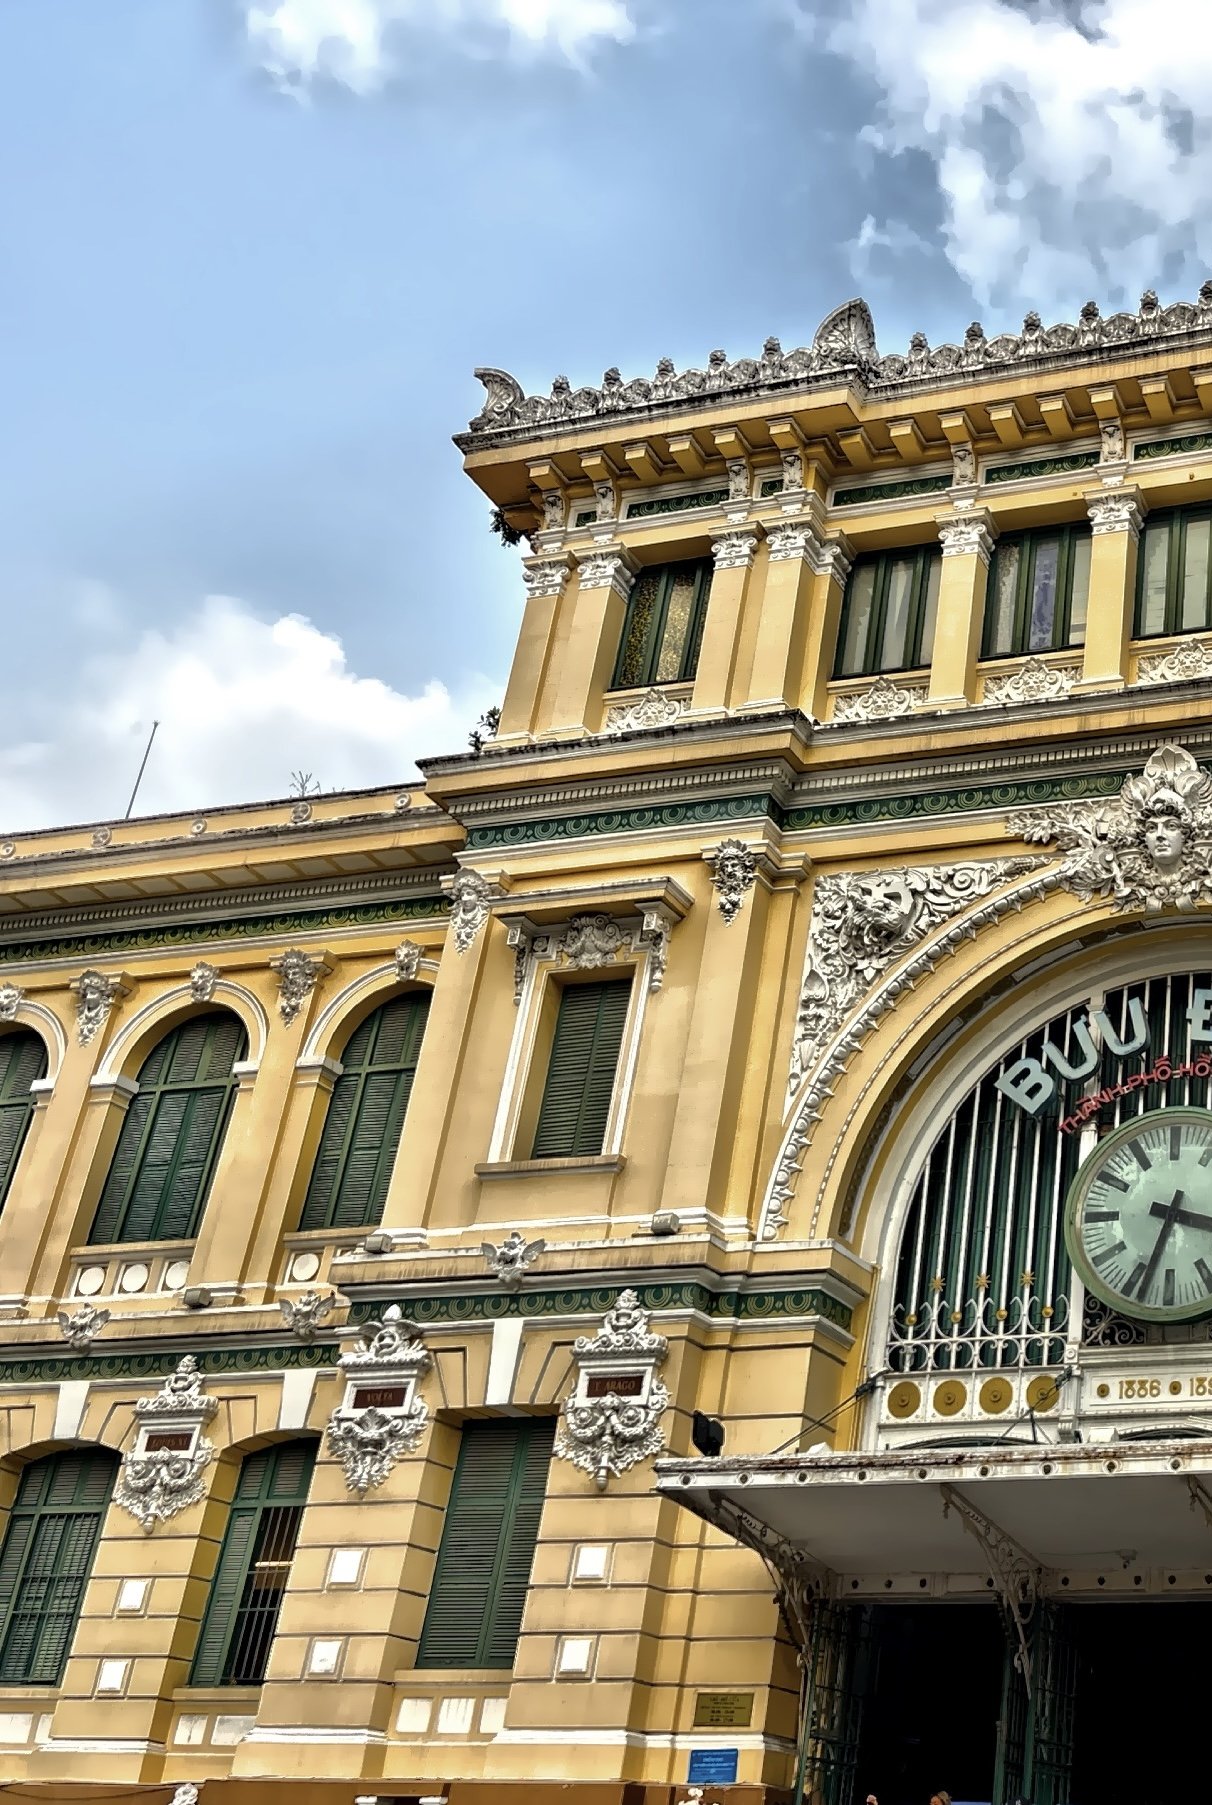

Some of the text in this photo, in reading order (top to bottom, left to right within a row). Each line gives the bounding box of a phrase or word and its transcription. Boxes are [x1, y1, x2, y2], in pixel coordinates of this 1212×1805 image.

[994, 996, 1148, 1115] BƯU
[604, 1380, 636, 1391] ARAGO
[1118, 1378, 1162, 1400] 1886
